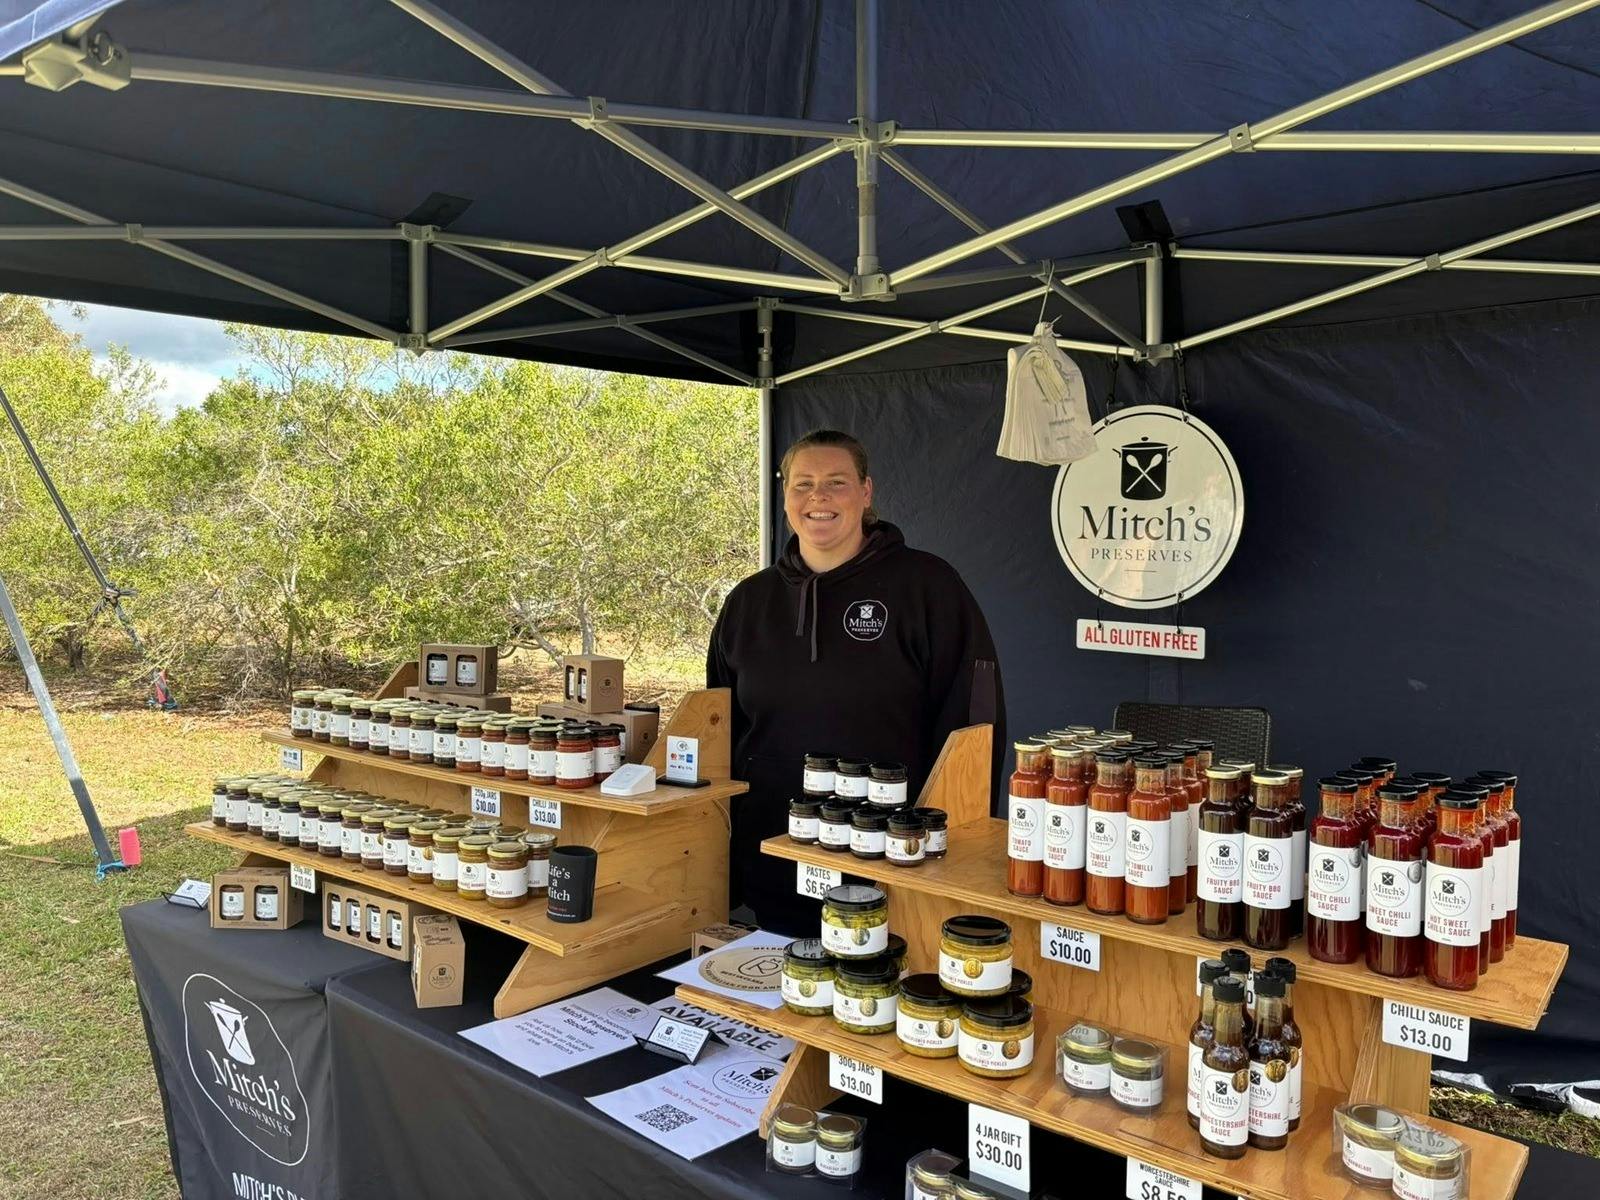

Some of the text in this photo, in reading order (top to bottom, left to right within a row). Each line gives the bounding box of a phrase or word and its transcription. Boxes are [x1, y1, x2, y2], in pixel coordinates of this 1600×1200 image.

[1078, 505, 1212, 542] Mitch's
[1091, 548, 1193, 562] PRESERVES
[849, 618, 883, 628] Mitch's
[1084, 626, 1198, 651] ALL GLUTEN FREE
[476, 799, 496, 814] $10.00
[534, 809, 556, 824] $13.00
[1012, 837, 1031, 847] TOMATO
[1013, 845, 1029, 853] SAUCE
[1047, 845, 1067, 854] TOMATO
[1048, 852, 1064, 861] SAUCE
[1091, 859, 1108, 869] SAUCE
[1209, 856, 1238, 866] Mitch's
[550, 865, 571, 880] ife's
[806, 865, 831, 880] PASTES
[1250, 859, 1279, 871] Mitch's
[552, 879, 558, 887] a
[1206, 877, 1228, 887] FRUITY
[1314, 869, 1345, 882] Mitch's
[1246, 881, 1281, 893] FRUITY BBQ
[1373, 882, 1406, 896] Mitch's
[1252, 891, 1273, 900] SAUCE
[1310, 890, 1351, 904] SWEET CHILLI
[1433, 891, 1466, 905] Mitch's
[1318, 902, 1339, 911] SAUCE
[1368, 904, 1411, 919] SWEET CHILLI
[1376, 916, 1399, 927] SAUCE
[1427, 921, 1471, 937] CHILLI SAUCE
[1430, 914, 1468, 929] HOT SWEET
[1056, 926, 1085, 943] SAUCE
[1050, 939, 1091, 964] $10.00
[560, 1006, 628, 1041] Mitch's Preserves
[1390, 1002, 1464, 1031] CHILLI SAUCE
[563, 1018, 598, 1036] Stockist
[660, 1006, 778, 1051] AVAILABLE
[1400, 1024, 1452, 1052] $13.00
[857, 1061, 875, 1076] JARS
[206, 1050, 296, 1121] Mitch's
[723, 1070, 772, 1095] Mitch's
[840, 1073, 872, 1096] $13.00
[699, 1087, 715, 1096] here
[1207, 1089, 1239, 1105] Mitch's
[683, 1097, 715, 1115] Preserves
[228, 1095, 292, 1137] PRESERVES
[975, 1123, 1022, 1148] 4 JAR GIFT
[1210, 1124, 1231, 1137] SAUCE
[976, 1140, 1022, 1171] $30.00
[1139, 1163, 1191, 1188] WORCESTERSHIRE
[1154, 1176, 1174, 1189] SAUCE
[232, 1172, 284, 1200] MITCH'S
